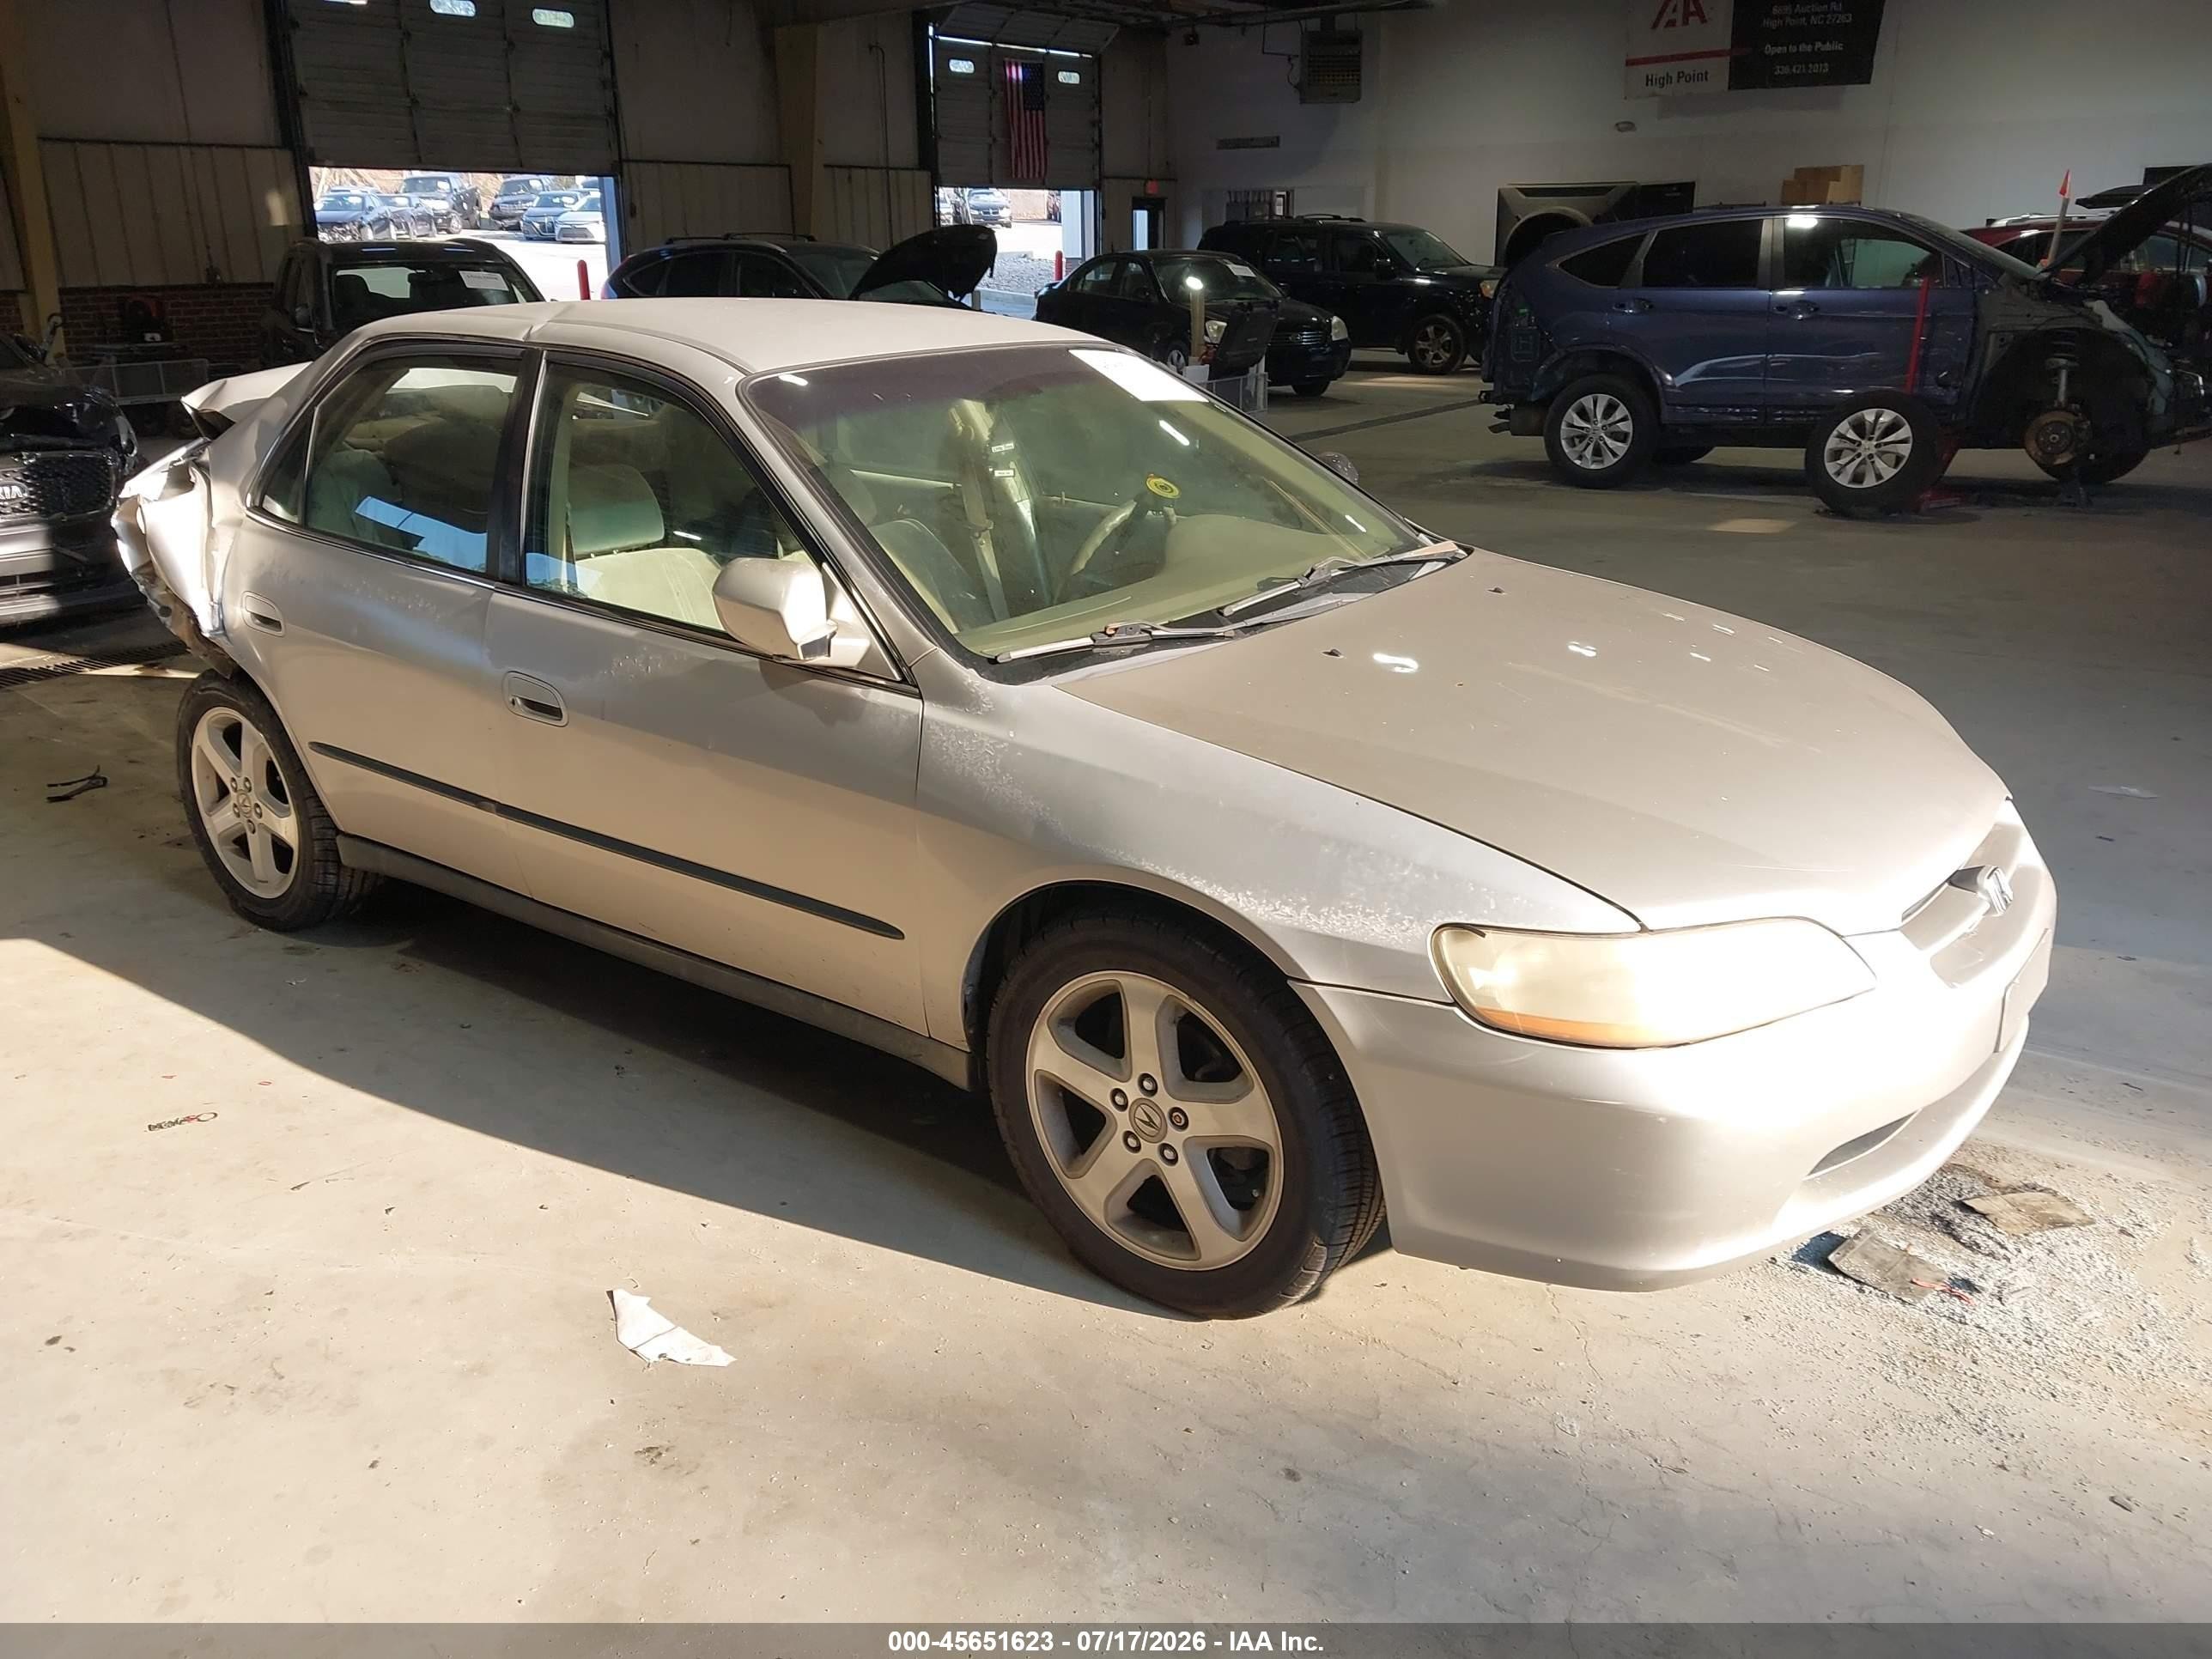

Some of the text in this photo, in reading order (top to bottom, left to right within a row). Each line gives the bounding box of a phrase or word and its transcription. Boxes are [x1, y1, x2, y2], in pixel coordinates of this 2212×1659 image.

[1794, 3, 1828, 14] Auction
[1763, 17, 1784, 29] High
[1810, 15, 1825, 25] NC
[1765, 40, 1844, 56] Open to the Public
[1645, 70, 1709, 88] High Point
